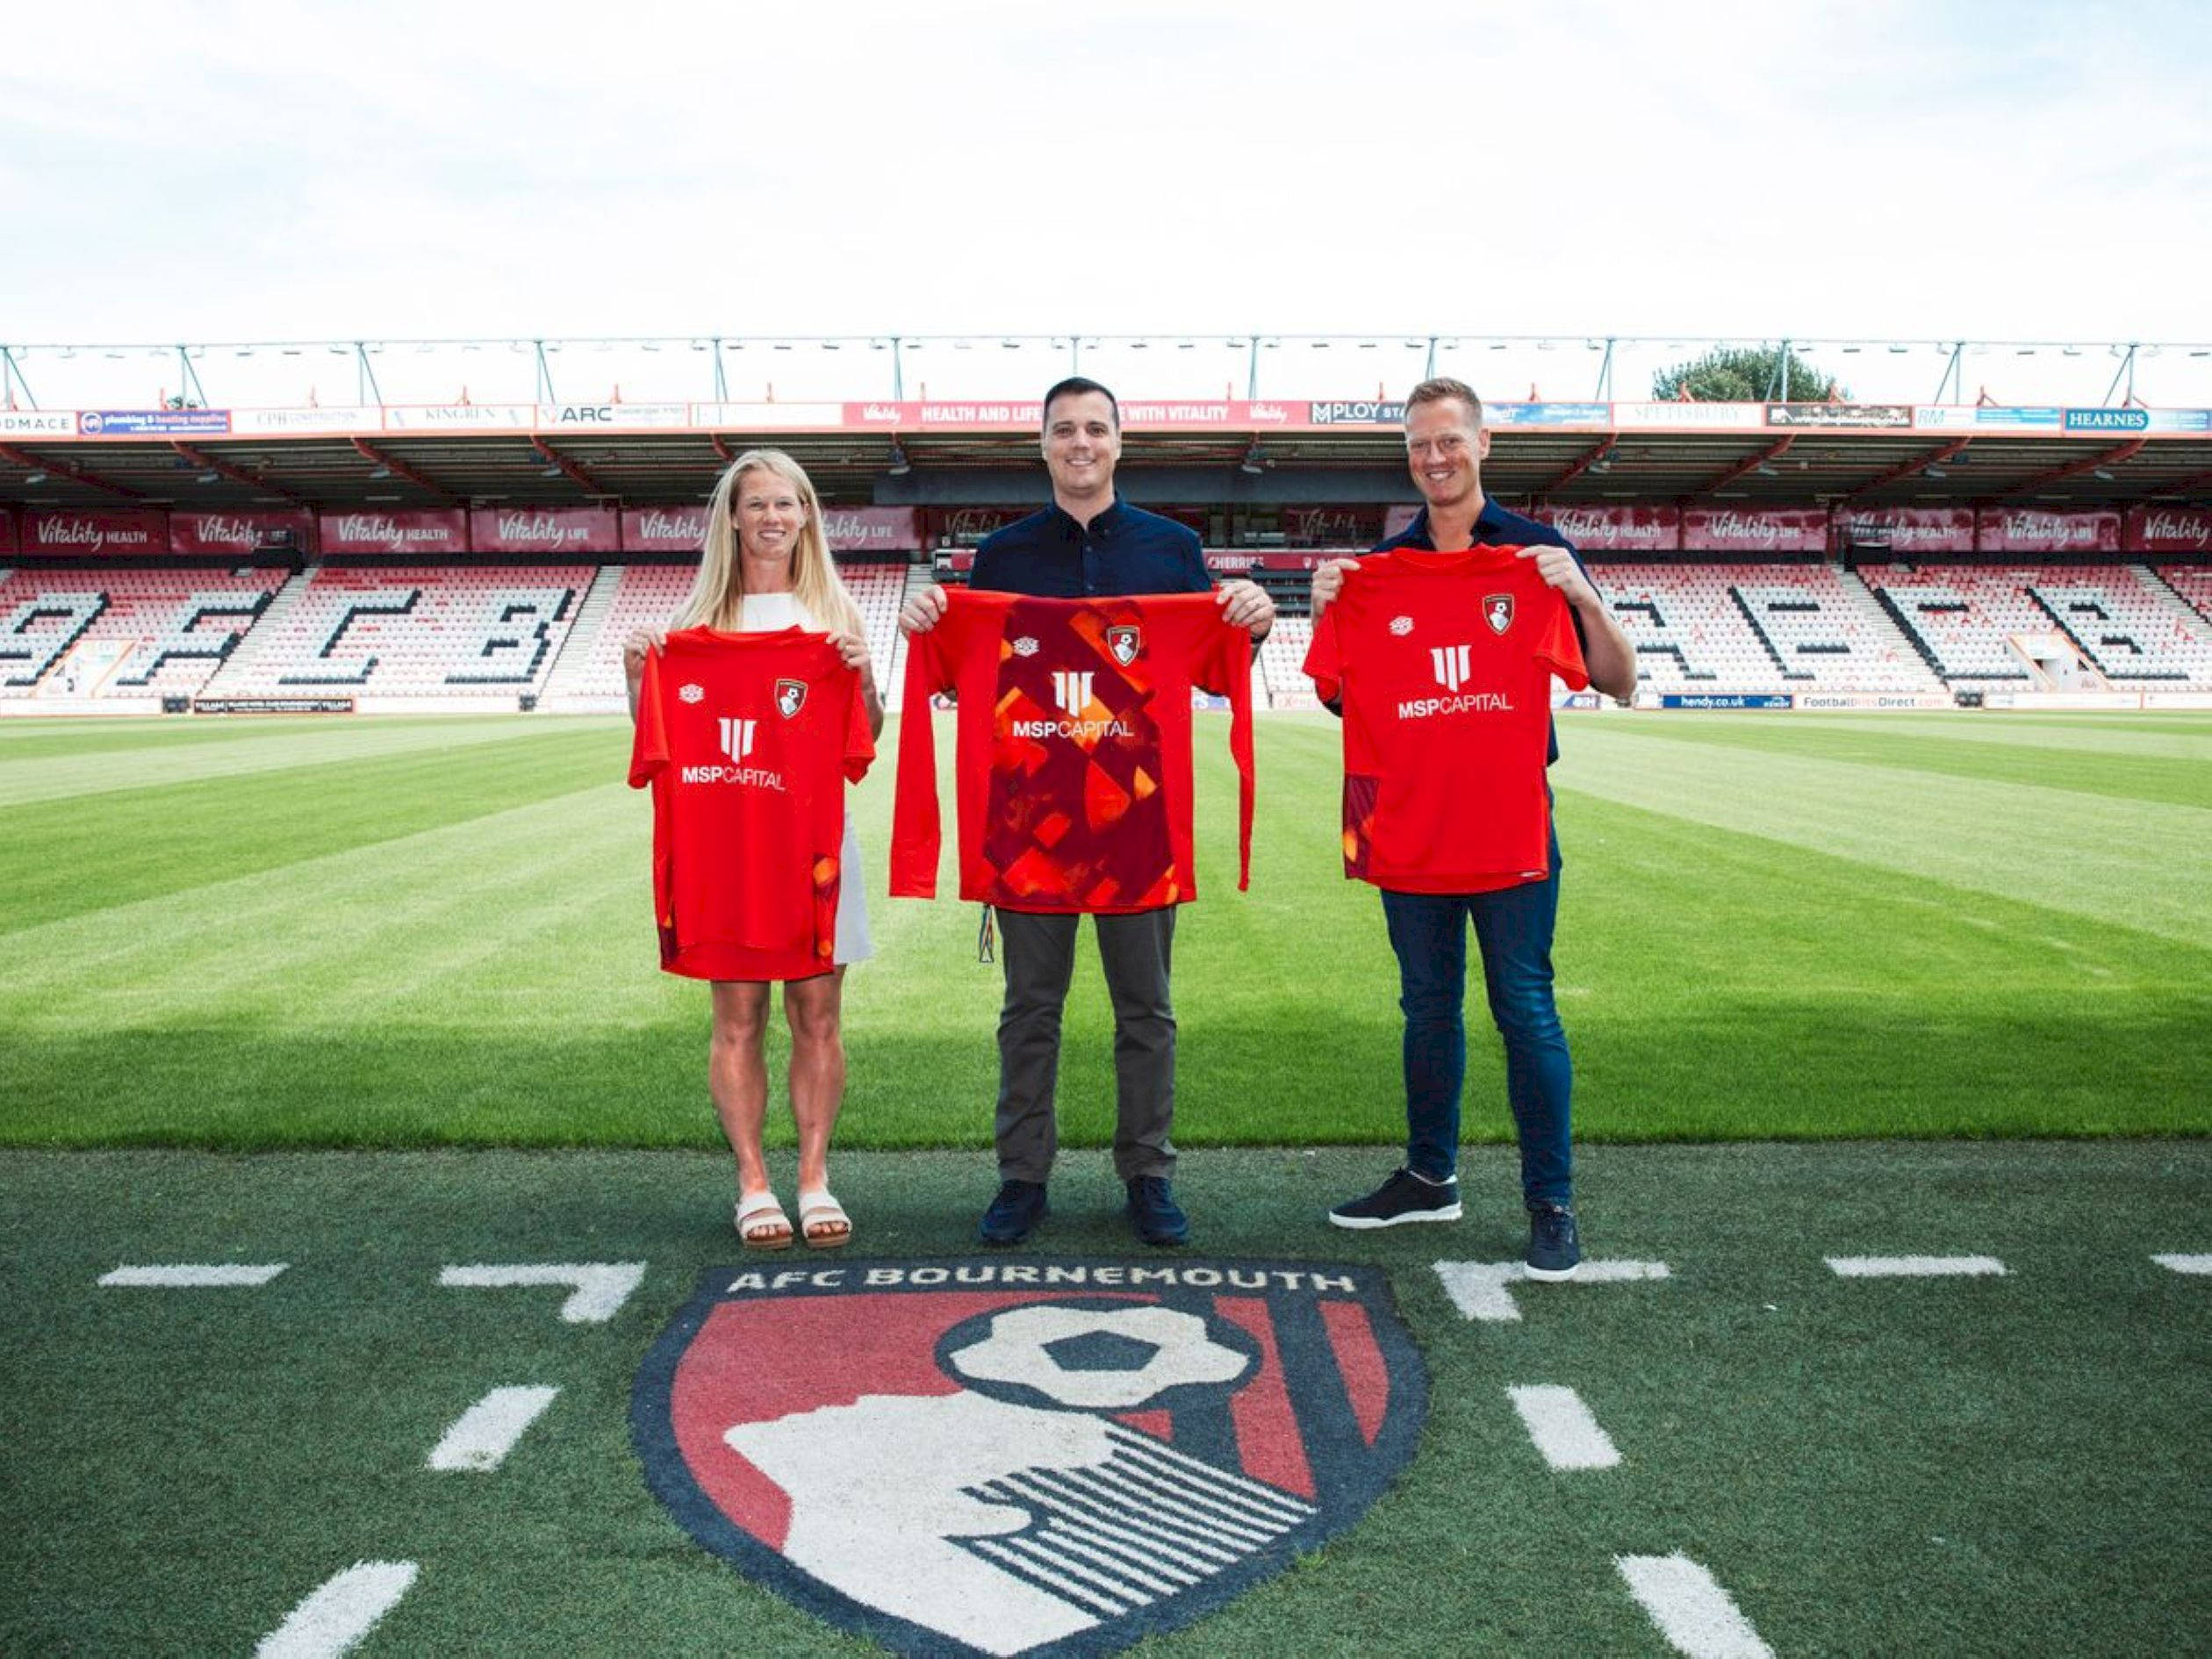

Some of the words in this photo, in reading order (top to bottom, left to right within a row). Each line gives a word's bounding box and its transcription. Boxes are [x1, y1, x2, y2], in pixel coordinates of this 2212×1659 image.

[0, 418, 69, 429] DMACE
[561, 407, 613, 421] ARC
[923, 406, 975, 422] HEALTH
[979, 406, 1009, 422] AND
[1013, 406, 1042, 422] LIFE
[1129, 406, 1166, 421] WITH
[1168, 406, 1228, 421] VITALITY
[2069, 413, 2146, 427] HEARNES
[38, 515, 103, 552] Vitality
[106, 530, 147, 542] HEALTH
[338, 514, 404, 549] Vitality
[406, 528, 449, 540] HEALTH
[499, 513, 564, 547] Vitality
[568, 528, 589, 539] LIFE
[1712, 512, 1775, 546] Vitality
[2145, 513, 2208, 547] Vitality
[1398, 693, 1514, 720] MSPCAPITAL
[1681, 695, 1746, 710] hendy.co.uk
[1012, 720, 1135, 737] MSPCAPITAL
[681, 765, 786, 792] MSPCAPITAL
[725, 1269, 846, 1294] AFC
[863, 1266, 1357, 1293] BOURNEMOUTH
